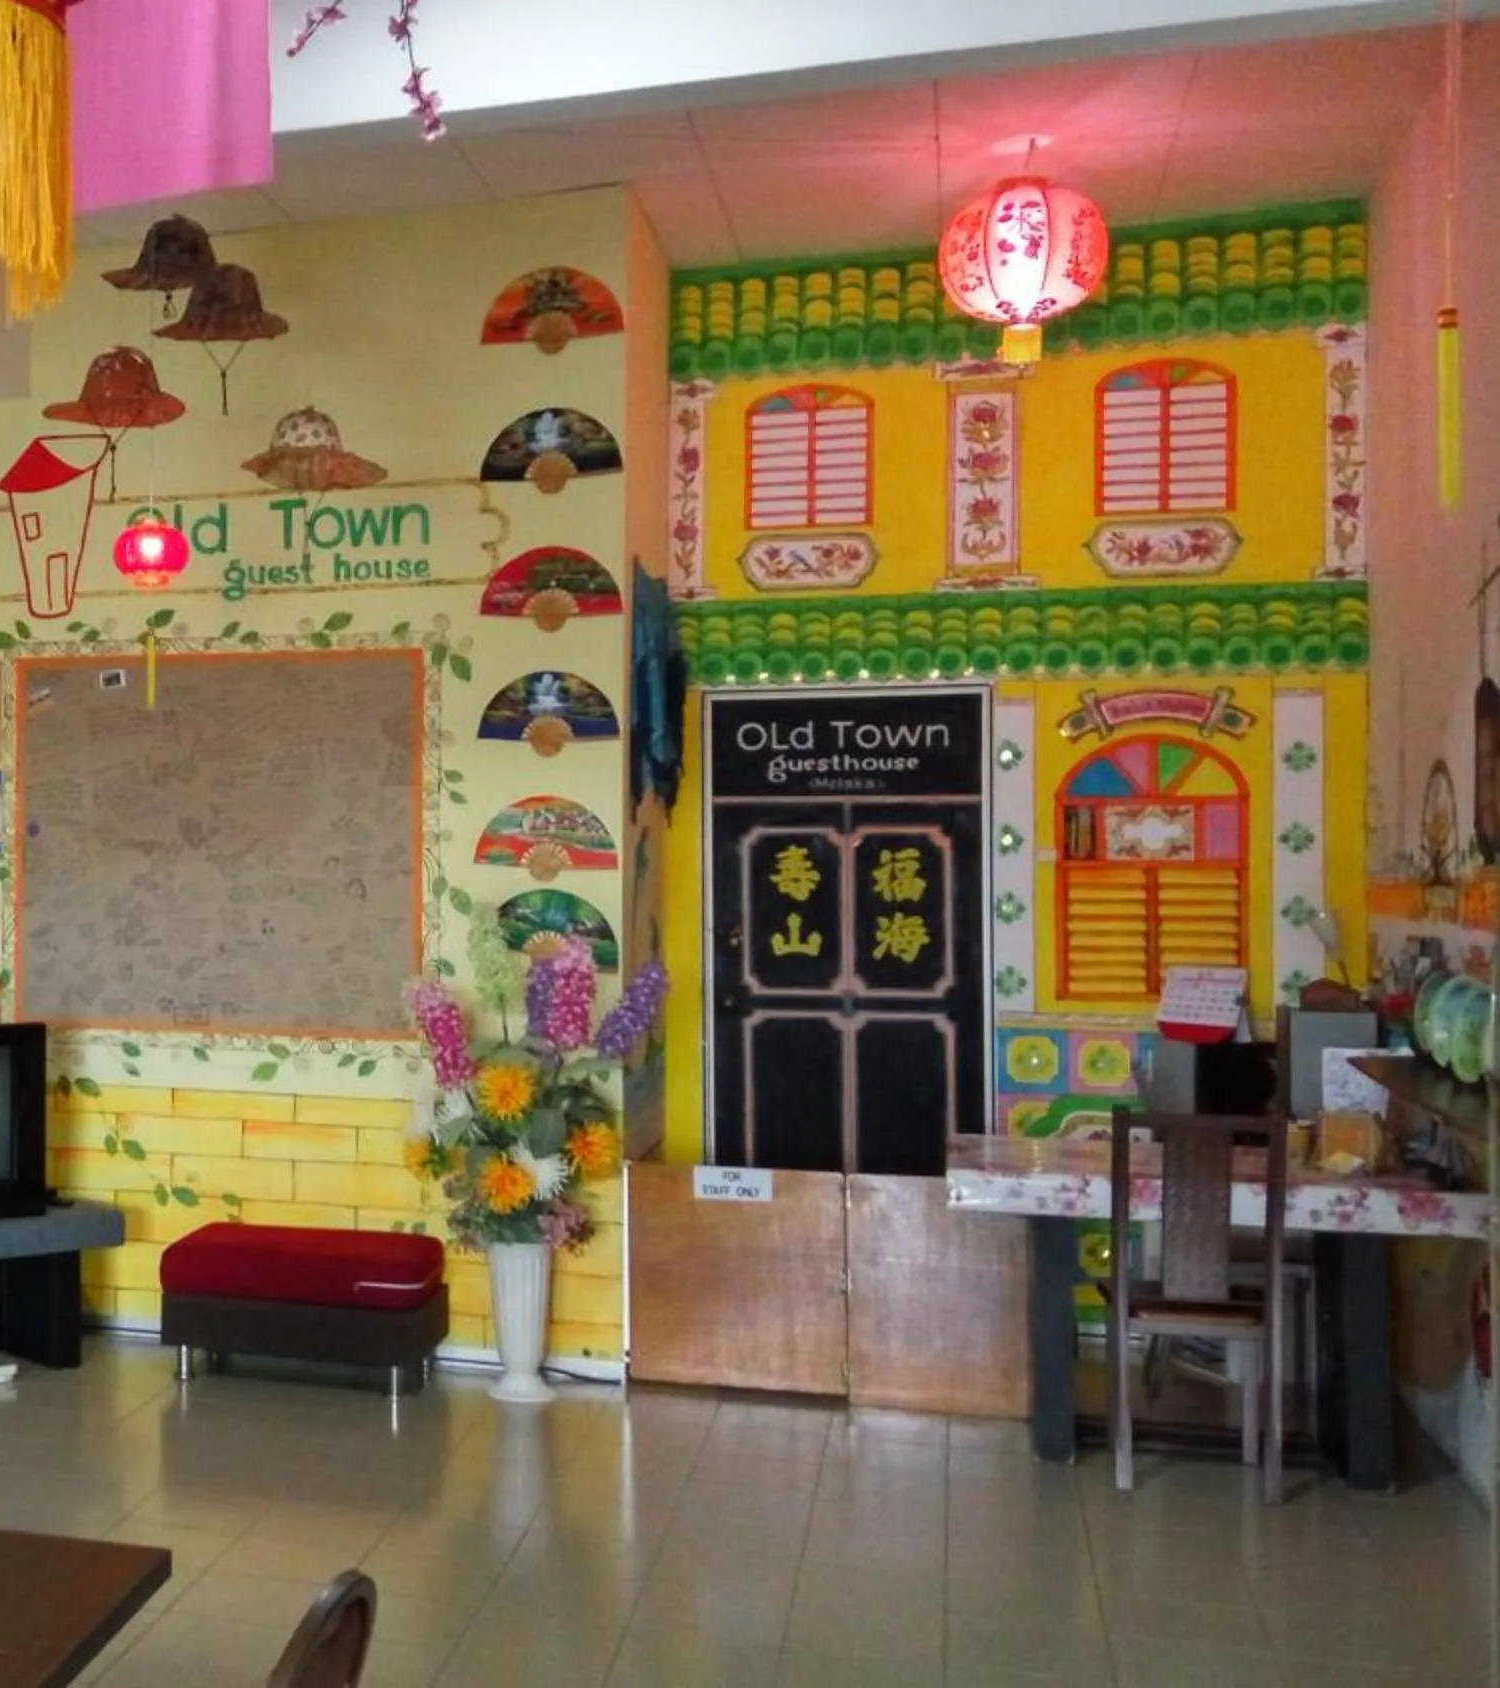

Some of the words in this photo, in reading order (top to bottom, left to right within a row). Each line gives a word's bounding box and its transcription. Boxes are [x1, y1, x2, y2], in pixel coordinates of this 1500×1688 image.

[269, 497, 430, 550] Town
[222, 553, 315, 601] guest
[333, 552, 431, 581] house
[829, 720, 950, 750] Town
[767, 753, 920, 783] guesthouse
[702, 1183, 730, 1195] STAFF
[736, 1185, 760, 1197] ONLY
[722, 1170, 741, 1182] FOR
